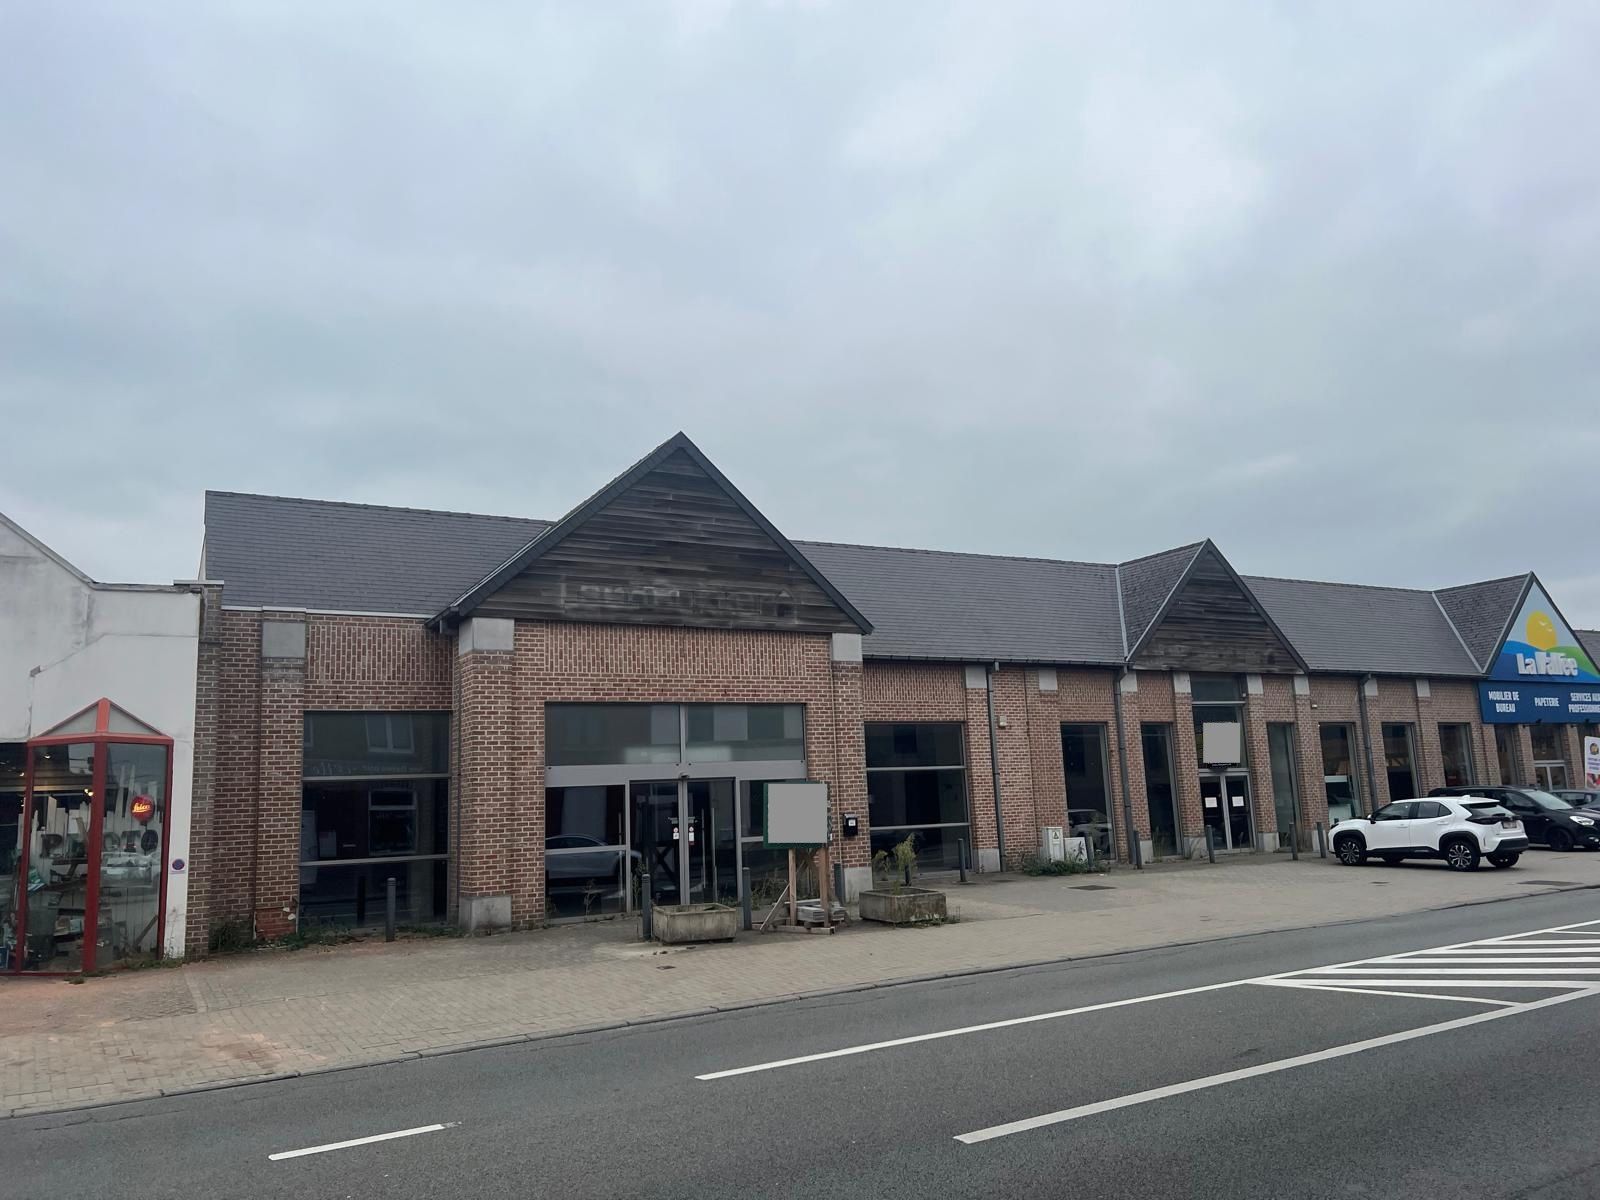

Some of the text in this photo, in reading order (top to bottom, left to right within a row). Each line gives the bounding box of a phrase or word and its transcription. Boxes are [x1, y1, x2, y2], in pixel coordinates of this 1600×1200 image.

[1516, 653, 1536, 674] La
[1488, 691, 1520, 701] MOBILIER DE
[1570, 693, 1591, 702] SERVICES
[1534, 697, 1560, 707] PAPETERIE
[1496, 703, 1515, 712] BUREAU
